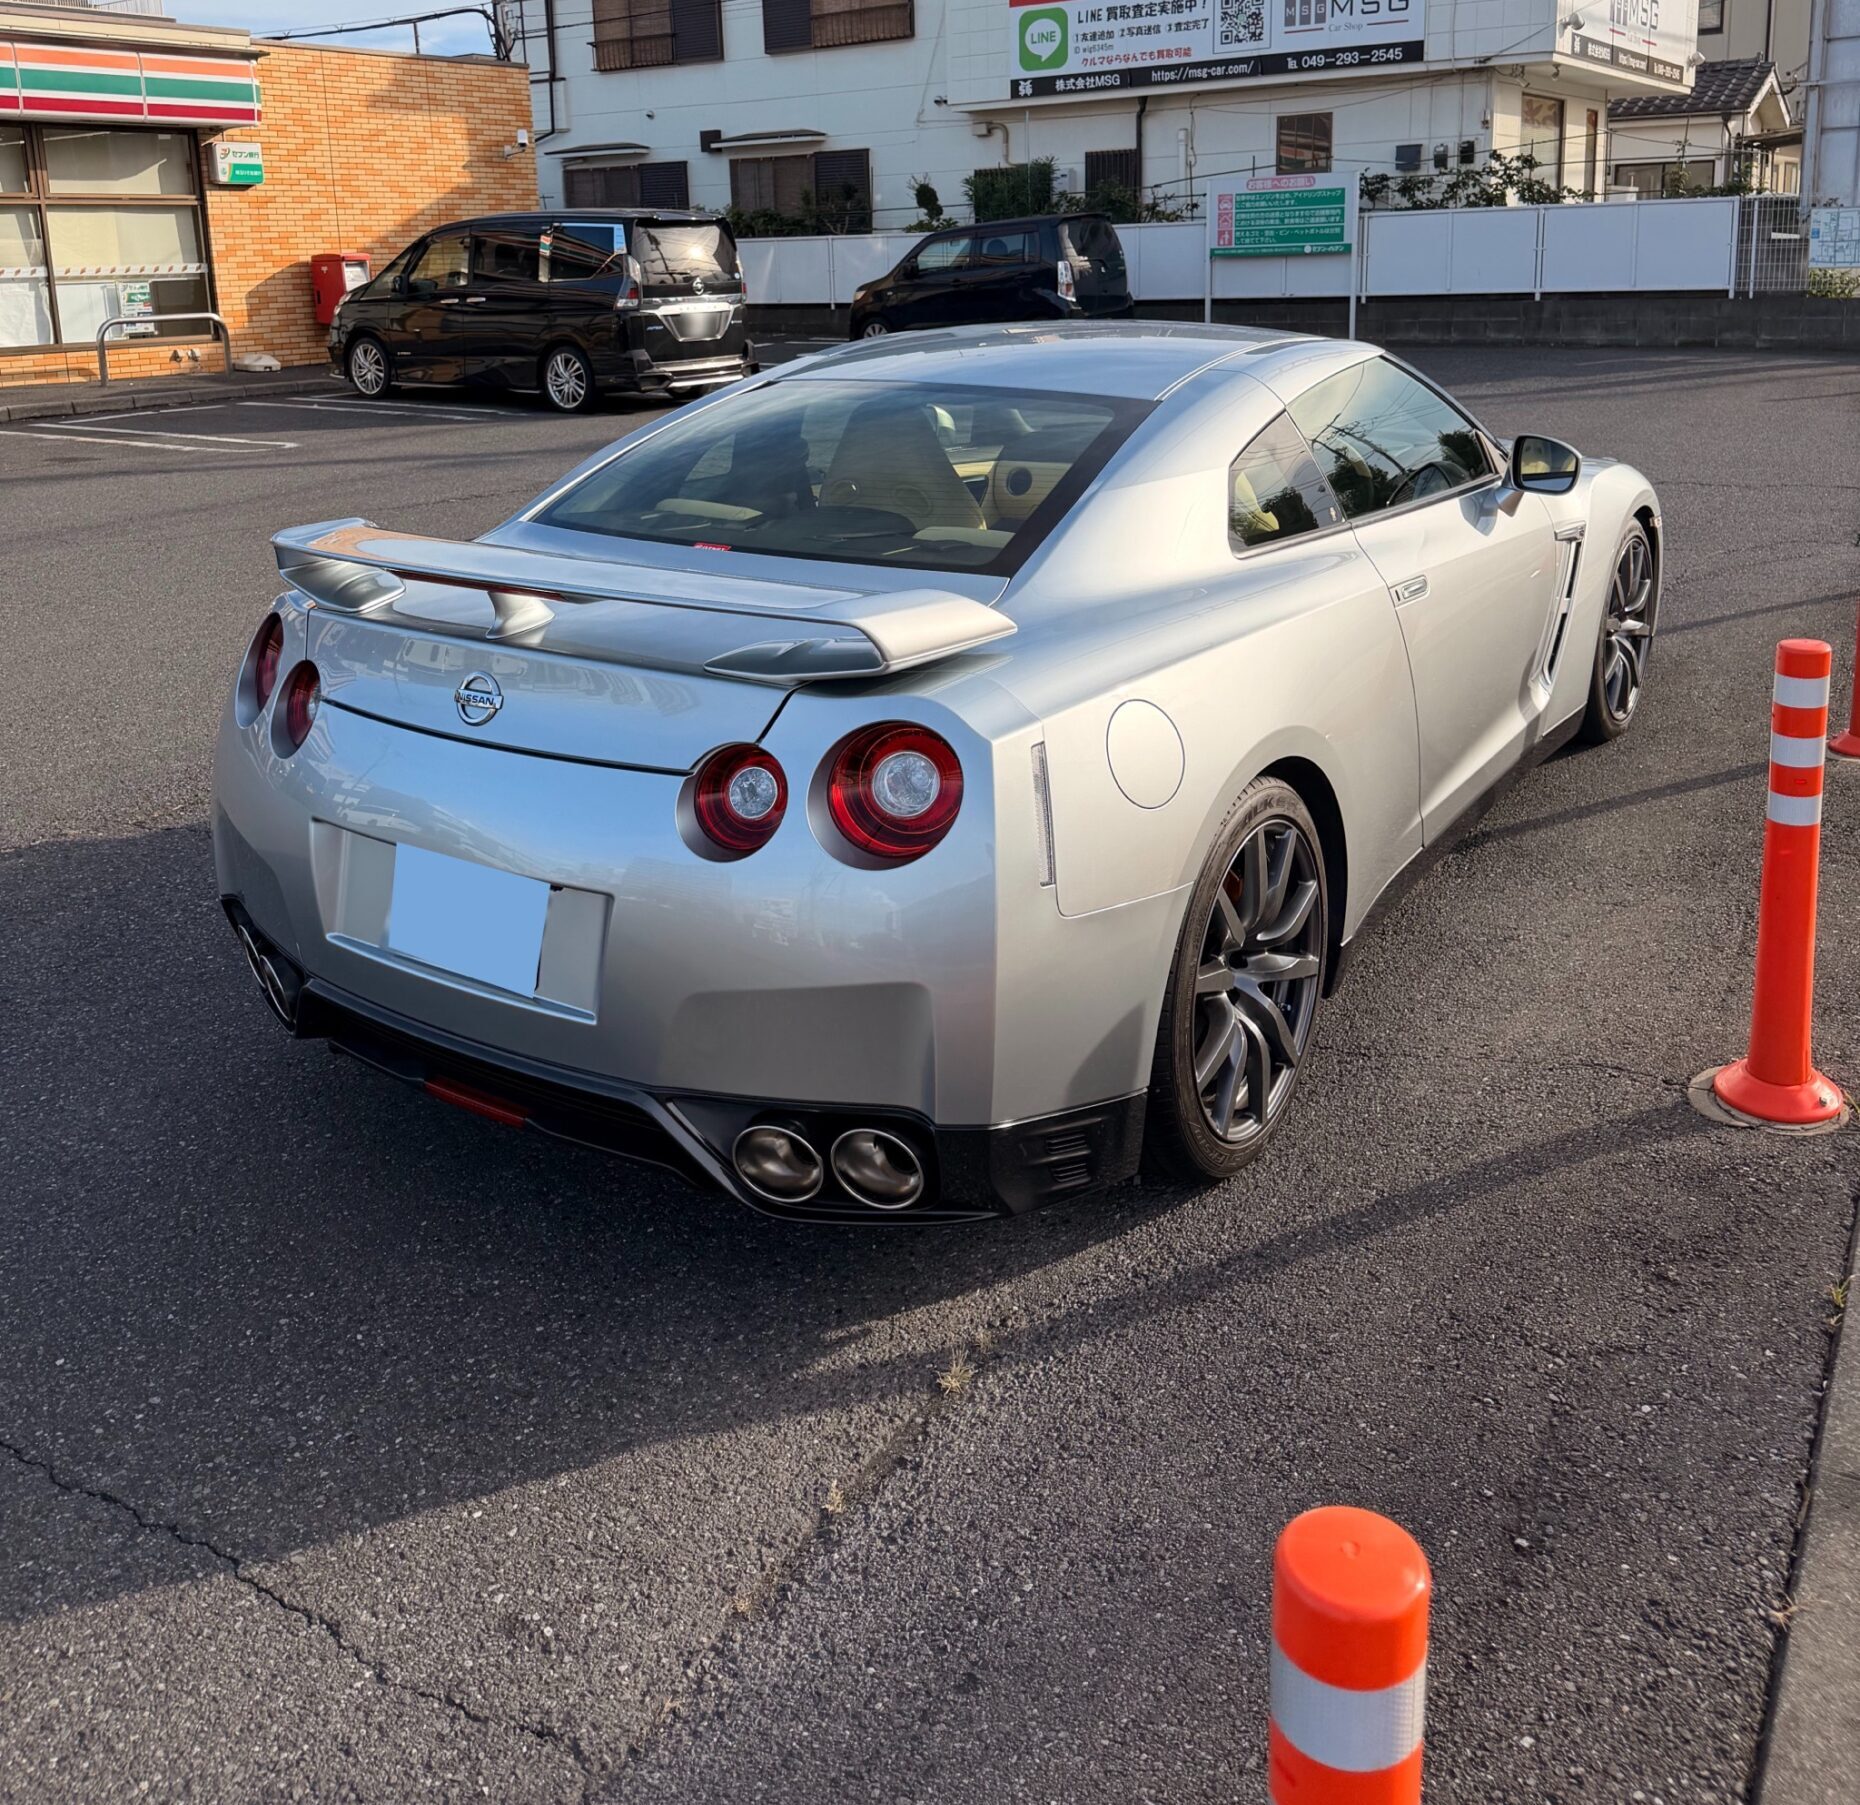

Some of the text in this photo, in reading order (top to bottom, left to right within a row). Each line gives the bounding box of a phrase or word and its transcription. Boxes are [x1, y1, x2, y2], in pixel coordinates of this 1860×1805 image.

[1078, 8, 1102, 24] LINE
[1328, 22, 1363, 32] Car Shop
[1030, 30, 1057, 45] LINE
[1301, 47, 1403, 68] 049-293-2545
[1151, 60, 1254, 82] https://msg-car.com/
[1055, 74, 1120, 92] 株式会社MSG
[458, 692, 494, 706] NISSAN
